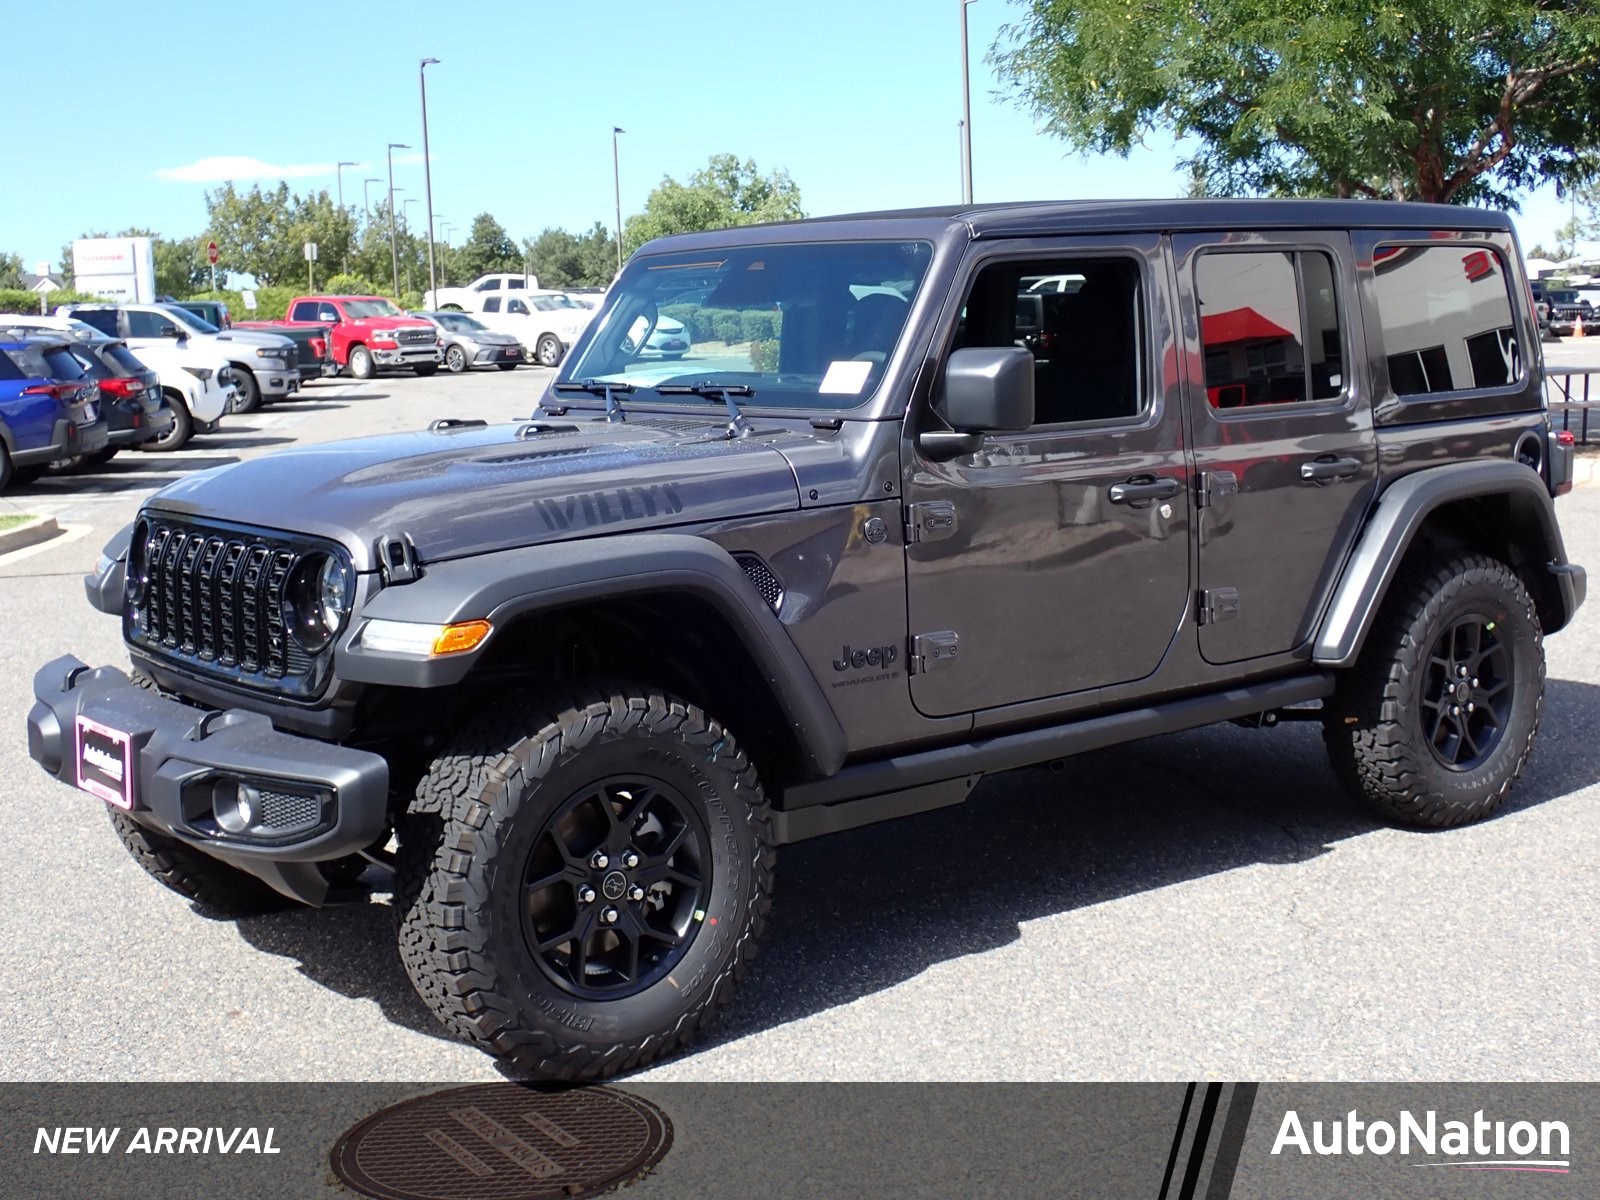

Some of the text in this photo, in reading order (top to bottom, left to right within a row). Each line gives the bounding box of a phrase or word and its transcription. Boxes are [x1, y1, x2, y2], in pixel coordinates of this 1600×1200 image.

[533, 481, 683, 531] WILLYS
[832, 644, 898, 672] Jeep
[831, 673, 890, 689] WRANGLER
